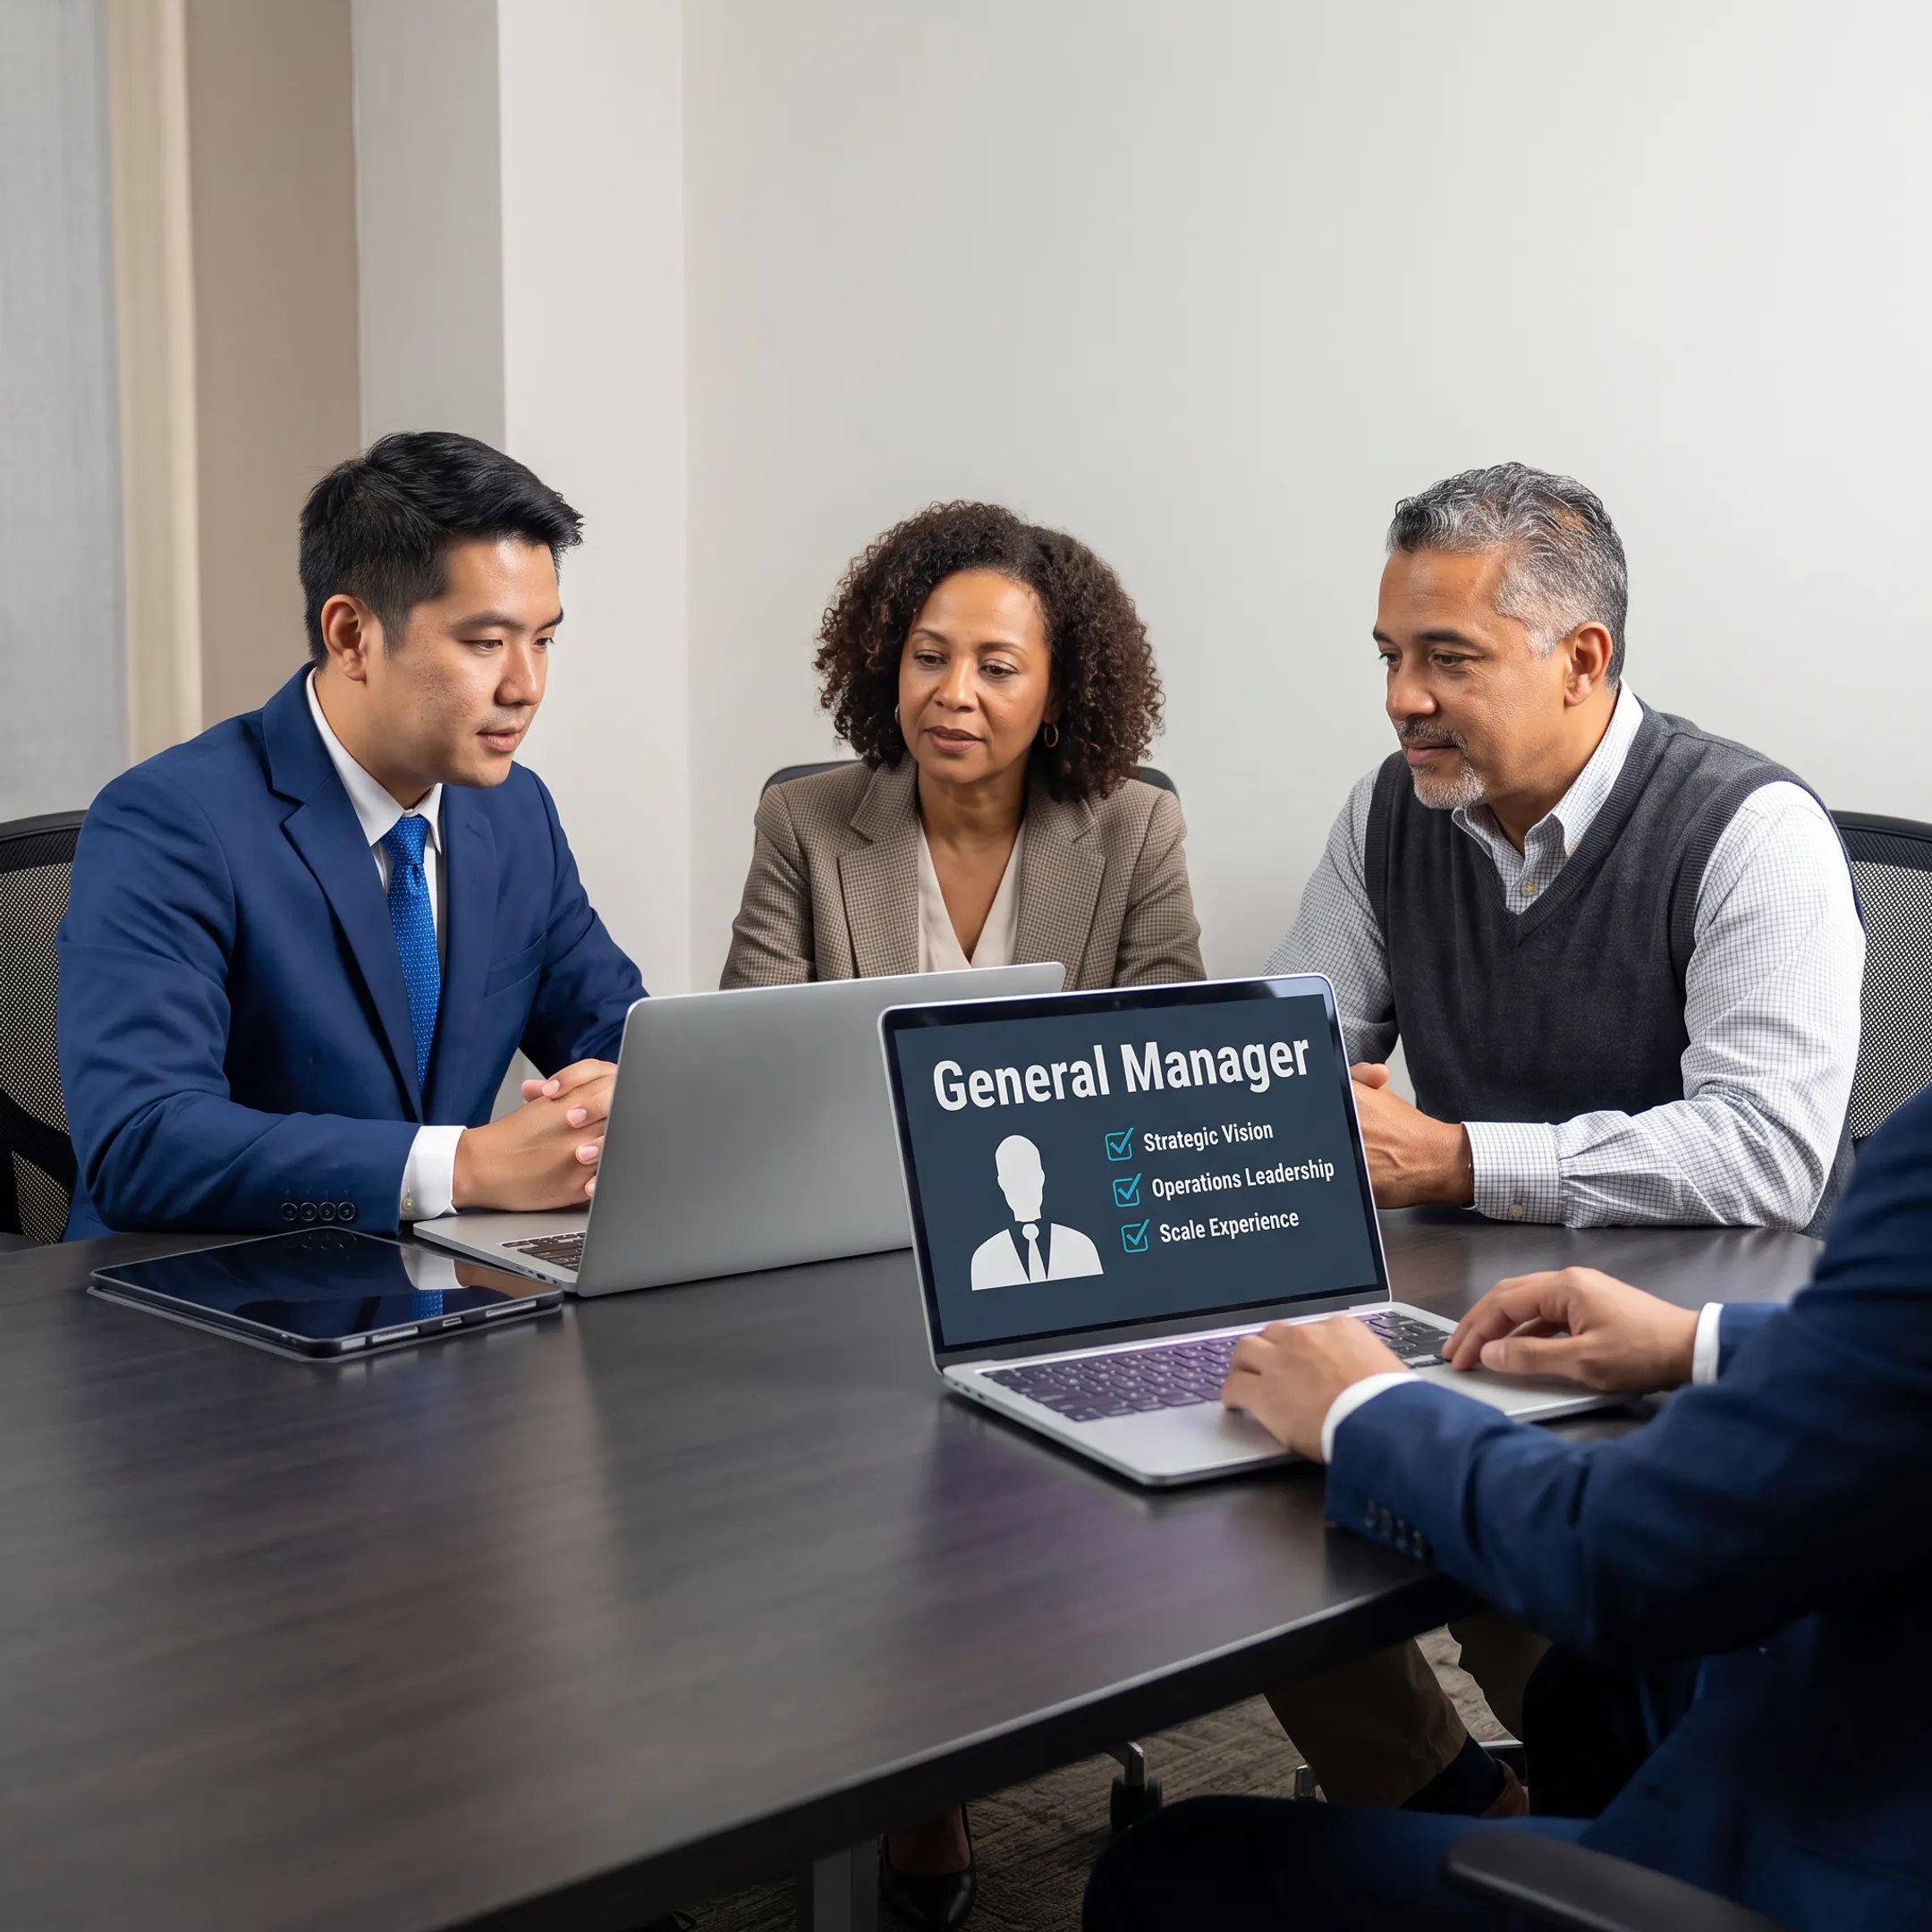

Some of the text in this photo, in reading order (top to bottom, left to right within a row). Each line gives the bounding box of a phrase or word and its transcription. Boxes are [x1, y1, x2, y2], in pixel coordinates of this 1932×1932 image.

[933, 1038, 1309, 1112] General Manager
[1143, 1121, 1274, 1152] Strategic Vision
[1151, 1158, 1335, 1201] Operations Leadership
[1159, 1212, 1300, 1243] Scale Experience
